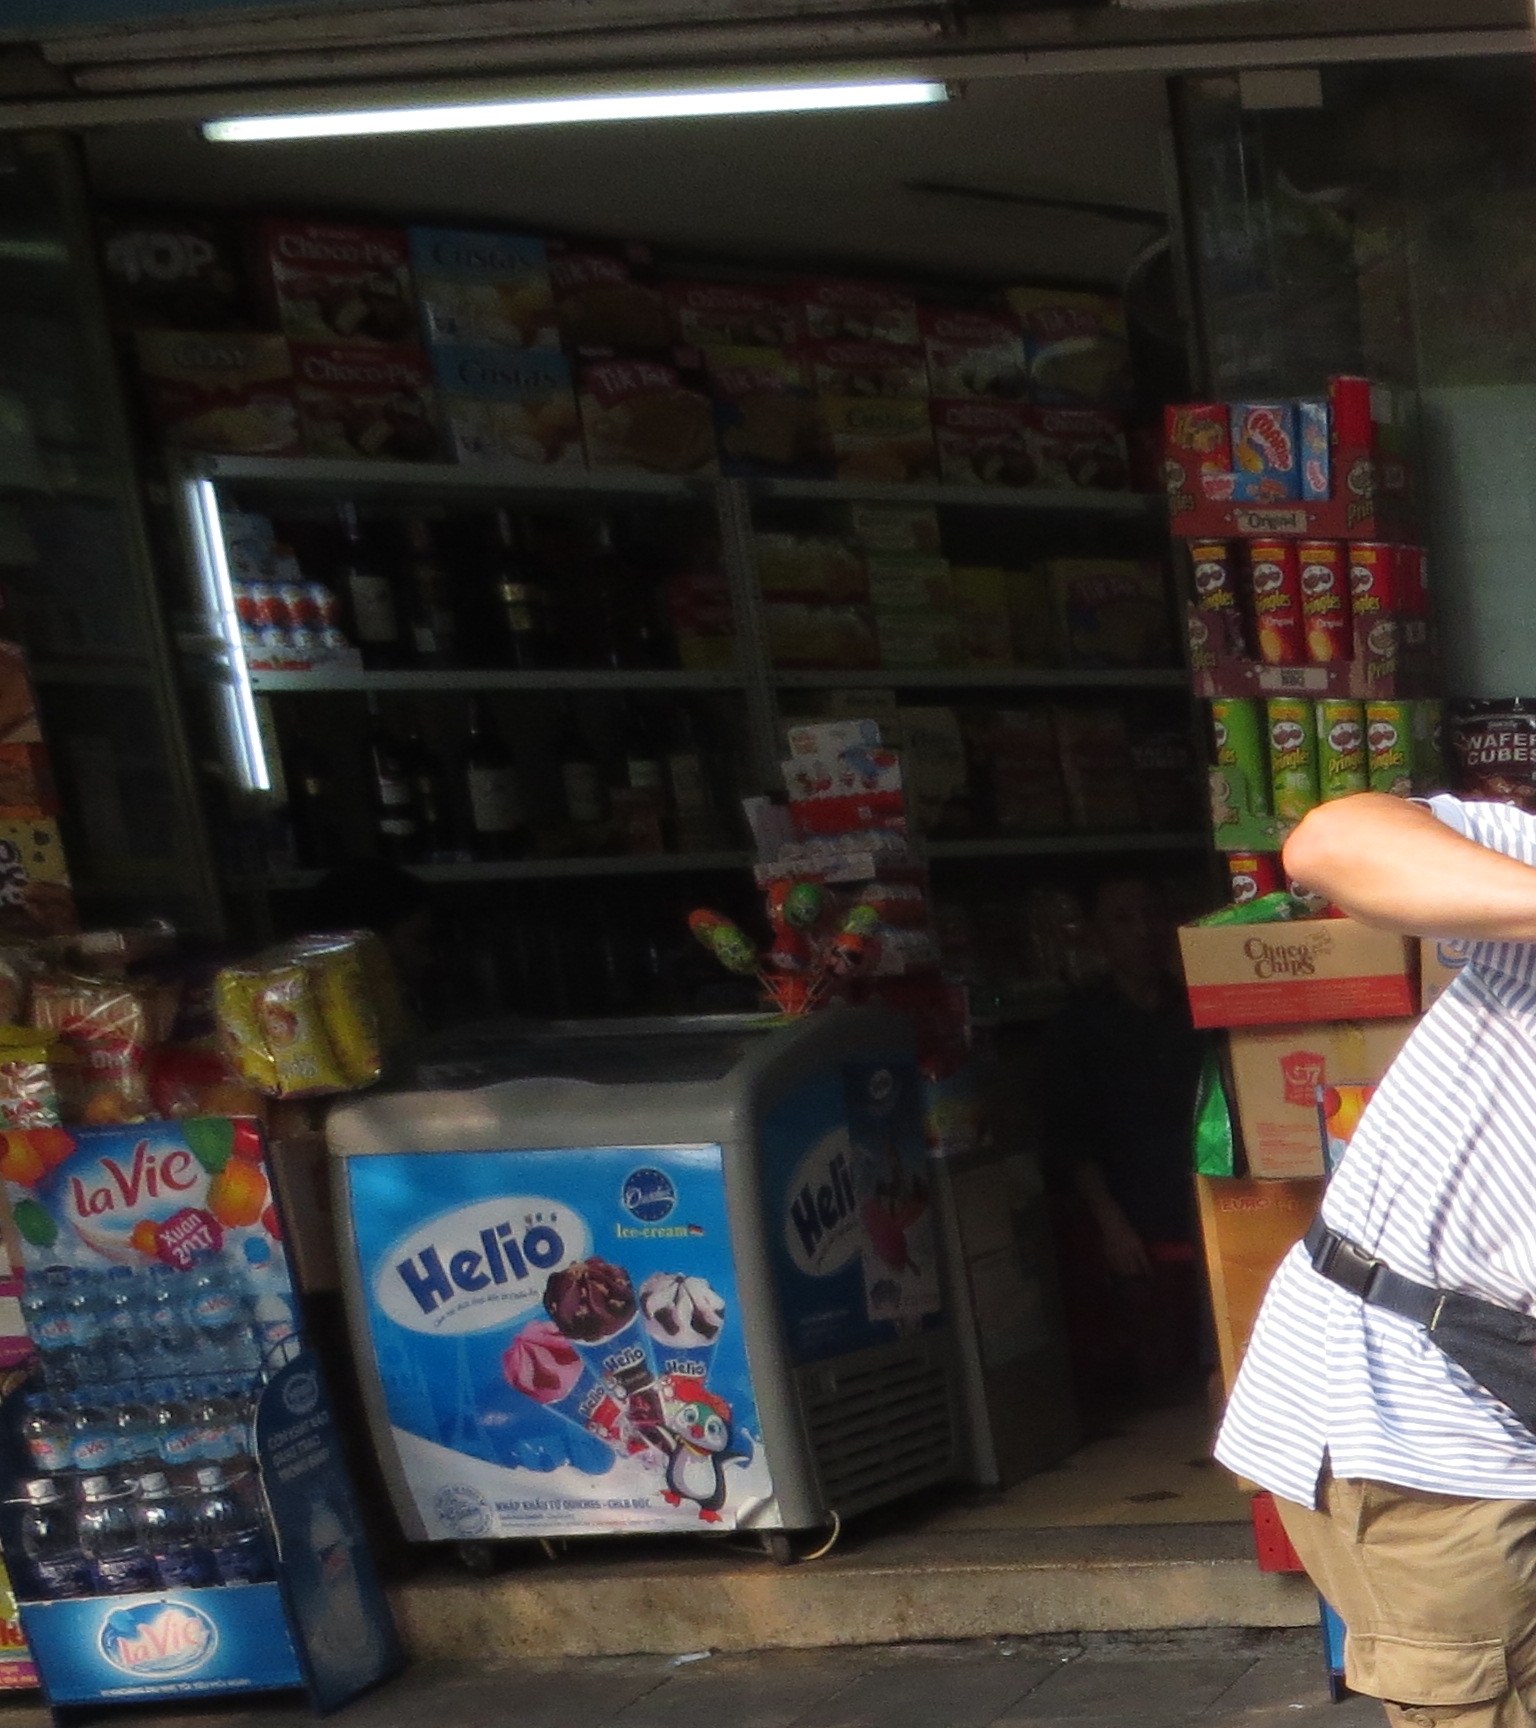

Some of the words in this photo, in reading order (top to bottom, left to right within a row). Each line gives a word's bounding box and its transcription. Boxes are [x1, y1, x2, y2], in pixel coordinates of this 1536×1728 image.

[1243, 937, 1308, 963] Choco
[1254, 954, 1316, 979] Chips
[790, 1151, 856, 1258] Heli
[615, 1223, 689, 1240] Ice-cream
[172, 1224, 215, 1266] 2017
[604, 1346, 645, 1372] Helio
[664, 1360, 707, 1376] Helio
